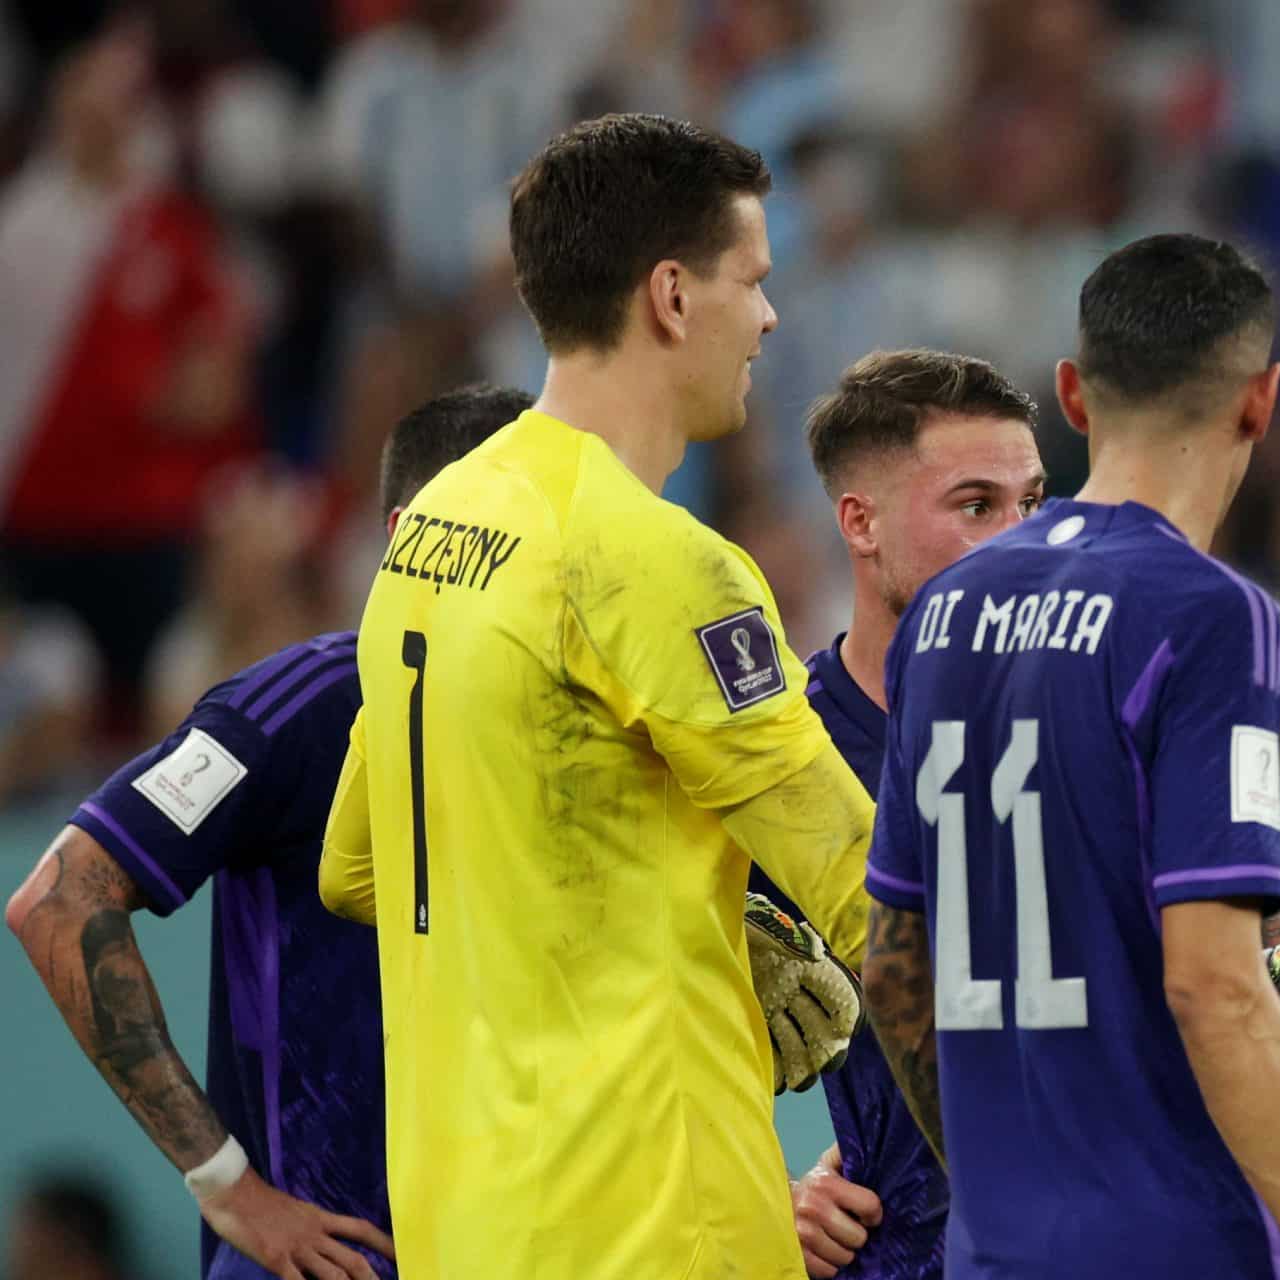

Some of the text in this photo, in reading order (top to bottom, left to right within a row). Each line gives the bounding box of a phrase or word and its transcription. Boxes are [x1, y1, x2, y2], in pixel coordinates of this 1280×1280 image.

[915, 589, 1114, 655] DI MARIA
[401, 629, 429, 935] 1
[916, 719, 1089, 1031] 11
